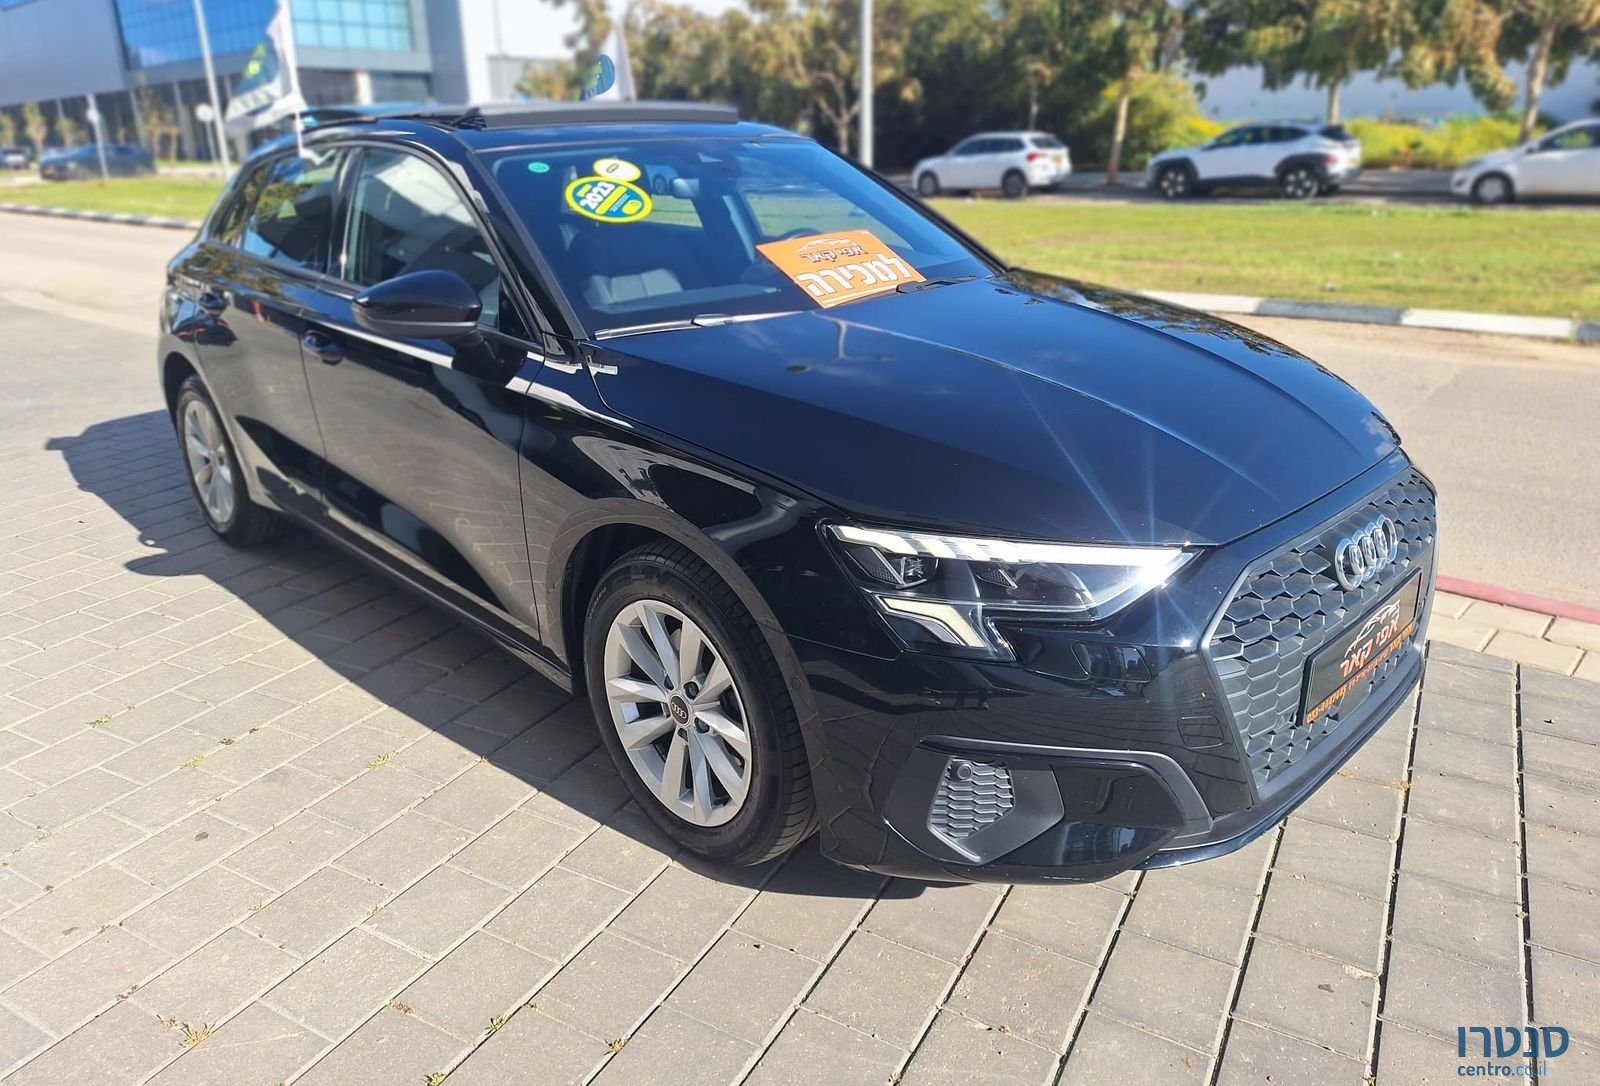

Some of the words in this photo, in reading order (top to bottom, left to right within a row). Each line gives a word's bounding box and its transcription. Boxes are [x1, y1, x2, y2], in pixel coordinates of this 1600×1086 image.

[579, 181, 616, 210] 2023
[795, 253, 913, 297] למכירה
[1375, 619, 1398, 647] אפי
[1339, 639, 1374, 678] קאר
